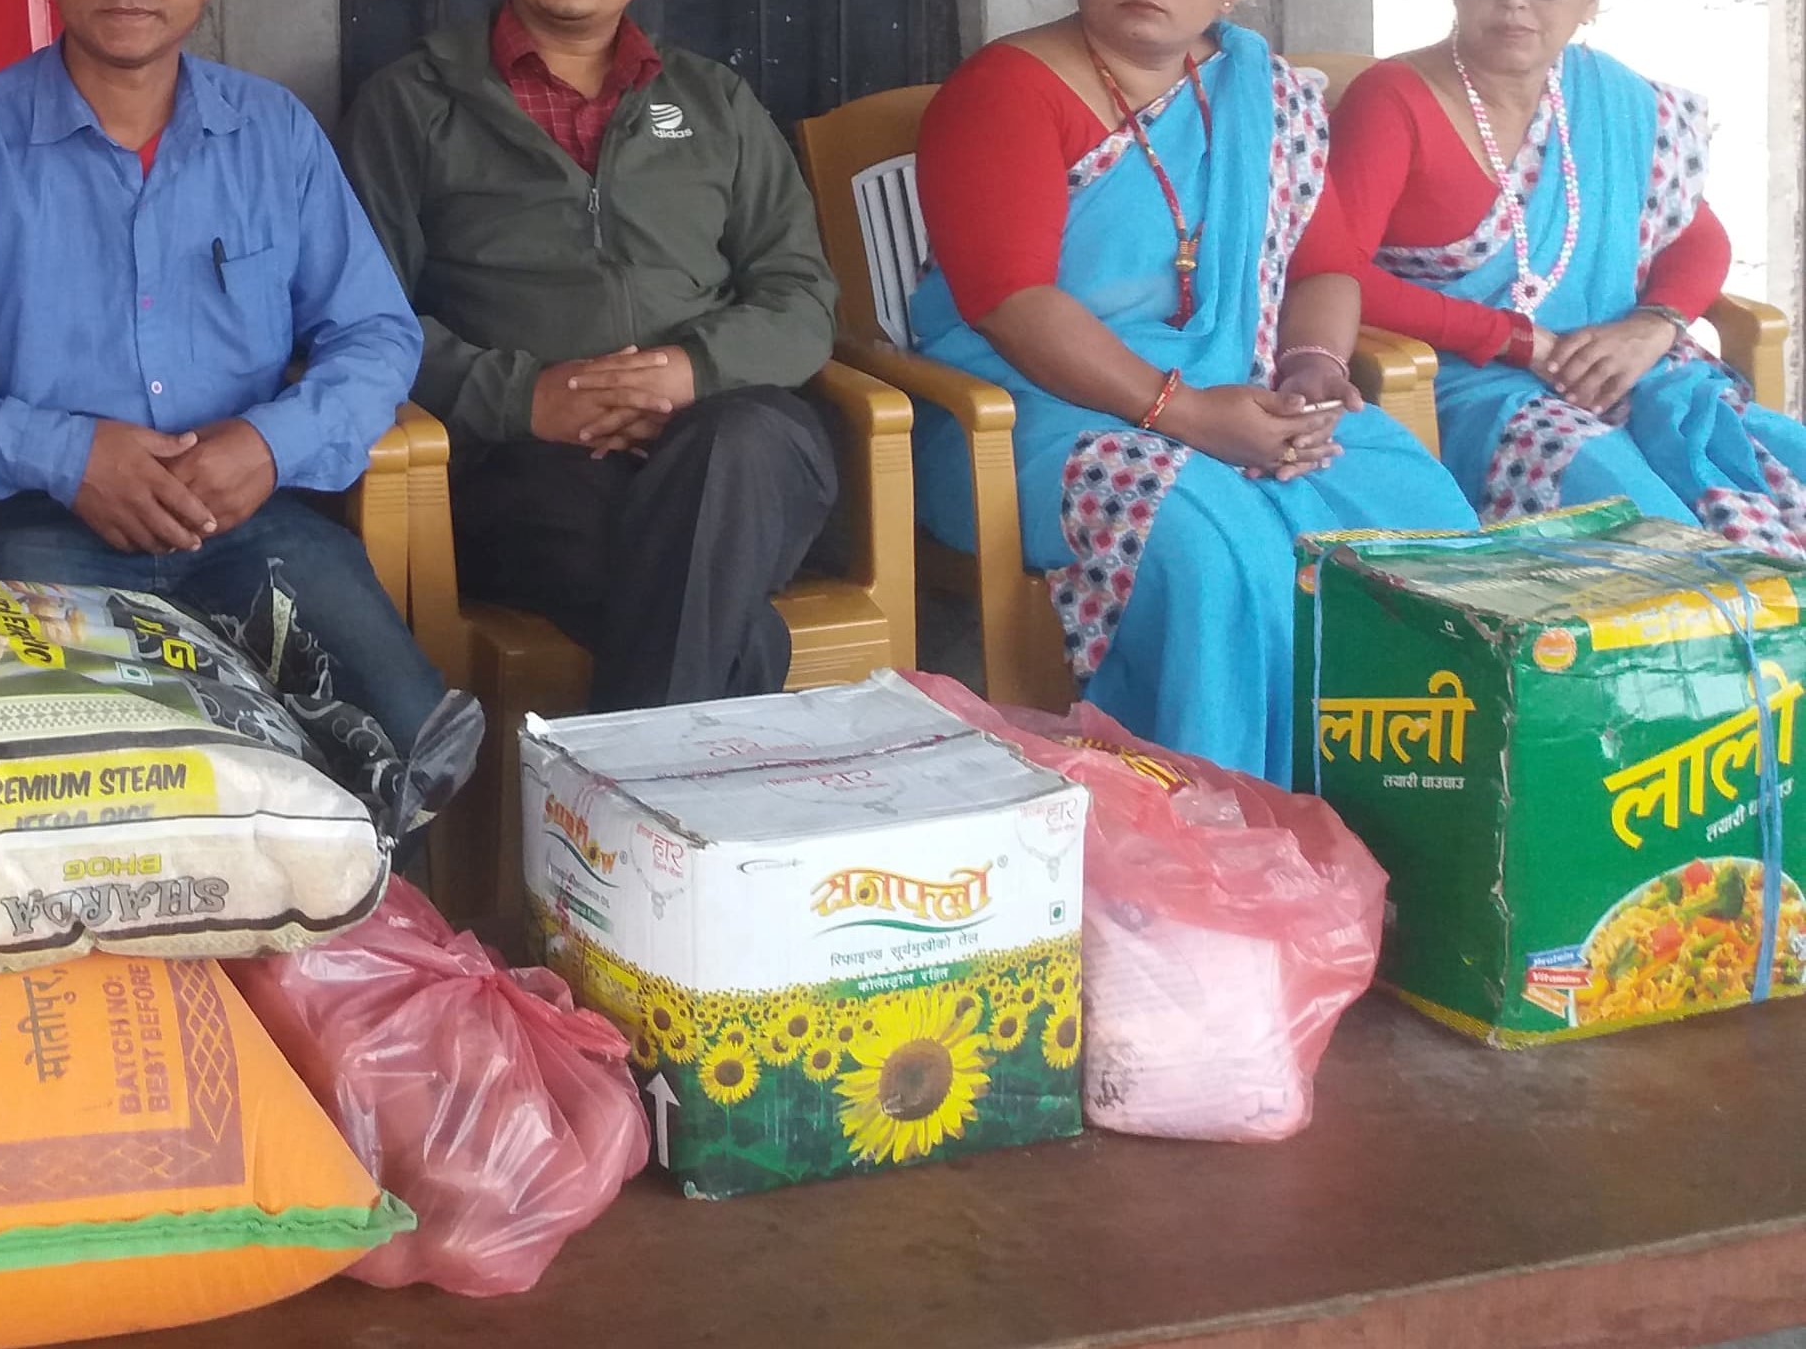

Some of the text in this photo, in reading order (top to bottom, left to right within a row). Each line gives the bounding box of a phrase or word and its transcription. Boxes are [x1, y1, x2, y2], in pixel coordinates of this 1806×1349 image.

[1312, 670, 1477, 765] लाली
[1603, 660, 1806, 850] लाली
[99, 763, 187, 797] STEAM
[2, 875, 231, 938] SHARDA
[63, 853, 162, 882] BHOG
[108, 1017, 143, 1115] BATCH
[128, 963, 170, 1113] BEST BEFORE
